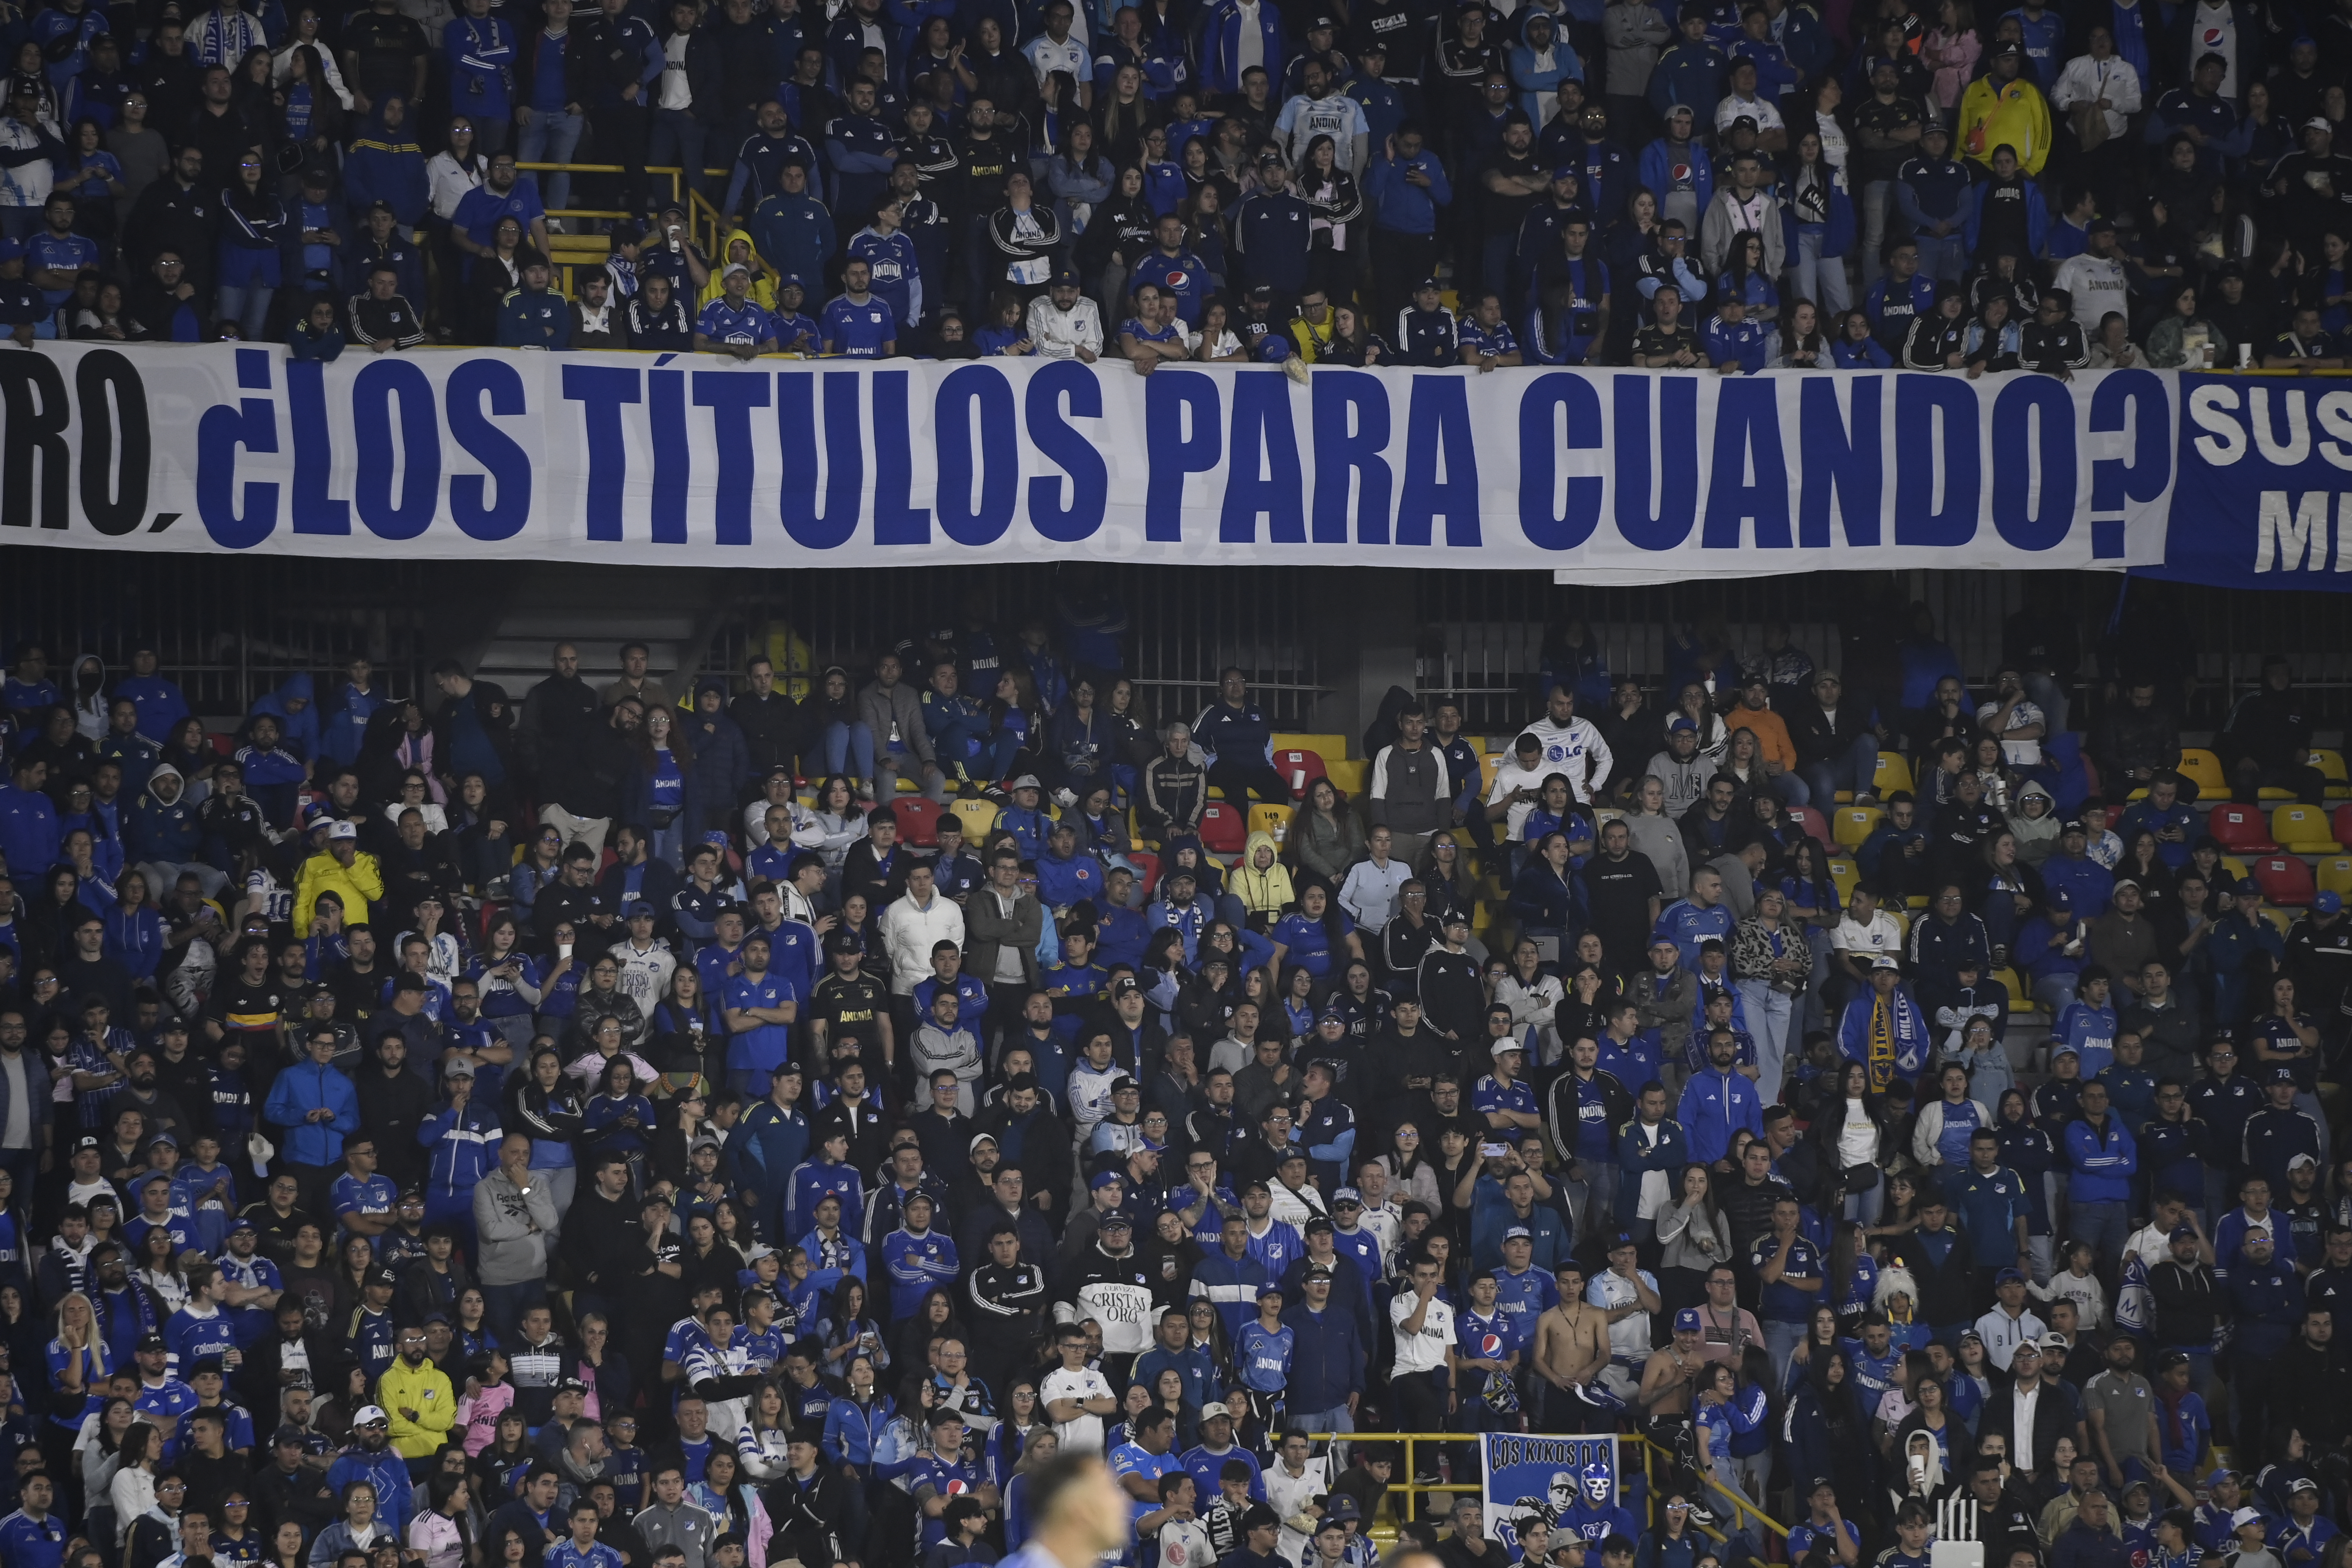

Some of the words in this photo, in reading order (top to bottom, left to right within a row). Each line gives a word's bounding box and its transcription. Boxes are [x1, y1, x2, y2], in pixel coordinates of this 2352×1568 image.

[666, 60, 685, 71] NDIN
[1310, 117, 1342, 131] ANDINA
[972, 165, 1003, 176] ANDINA
[1994, 188, 2020, 199] ADIDAS
[1015, 230, 1042, 242] ANDINA
[1117, 227, 1151, 239] Millonar
[873, 264, 902, 280] ANDINA
[2089, 280, 2124, 293] ANDINA
[1883, 303, 1914, 317] ANDINA
[197, 348, 532, 549] ¿LOS
[562, 354, 1108, 550] TÍTULOS
[1145, 370, 1483, 547] PARA
[1519, 369, 2170, 559] CUANDO?
[972, 656, 999, 670] NDINA
[1565, 746, 1582, 757] LG
[656, 779, 681, 788] ANDINA
[1264, 812, 1279, 820] 149
[269, 893, 293, 922] 10
[842, 936, 852, 946] NY
[489, 978, 513, 992] ANDIN
[840, 1008, 873, 1023] ANDINA
[2084, 1036, 2112, 1049] ANDINA
[2276, 1037, 2302, 1048] ANDIN
[2277, 1068, 2291, 1078] 78
[213, 1090, 250, 1104] ANDIA
[1579, 1105, 1607, 1122] ANDINA
[1944, 1119, 1971, 1129] ANDINA
[496, 1193, 524, 1203] Reeb
[166, 1205, 189, 1217] DINA
[1196, 1231, 1222, 1243] ANDIN
[1104, 1285, 1136, 1294] CERVEZA
[1495, 1300, 1526, 1313] ANDINA
[1106, 1306, 1137, 1324] ORO
[1997, 1335, 2002, 1347] 9
[373, 1343, 394, 1359] AND
[754, 1358, 773, 1368] NDINA
[1255, 1356, 1282, 1372] ANDIN
[689, 1367, 703, 1377] LEONA
[1856, 1372, 1890, 1391] ANDINA
[474, 1415, 498, 1426] AND
[963, 1435, 972, 1443] psi
[1489, 1434, 1521, 1474] LOS
[1523, 1438, 1577, 1468] KIKOS
[614, 1472, 639, 1485] DINA
[1212, 1506, 1234, 1555] MILLO
[445, 1541, 463, 1552] ANDIN
[1093, 1549, 1124, 1560] NDINA
